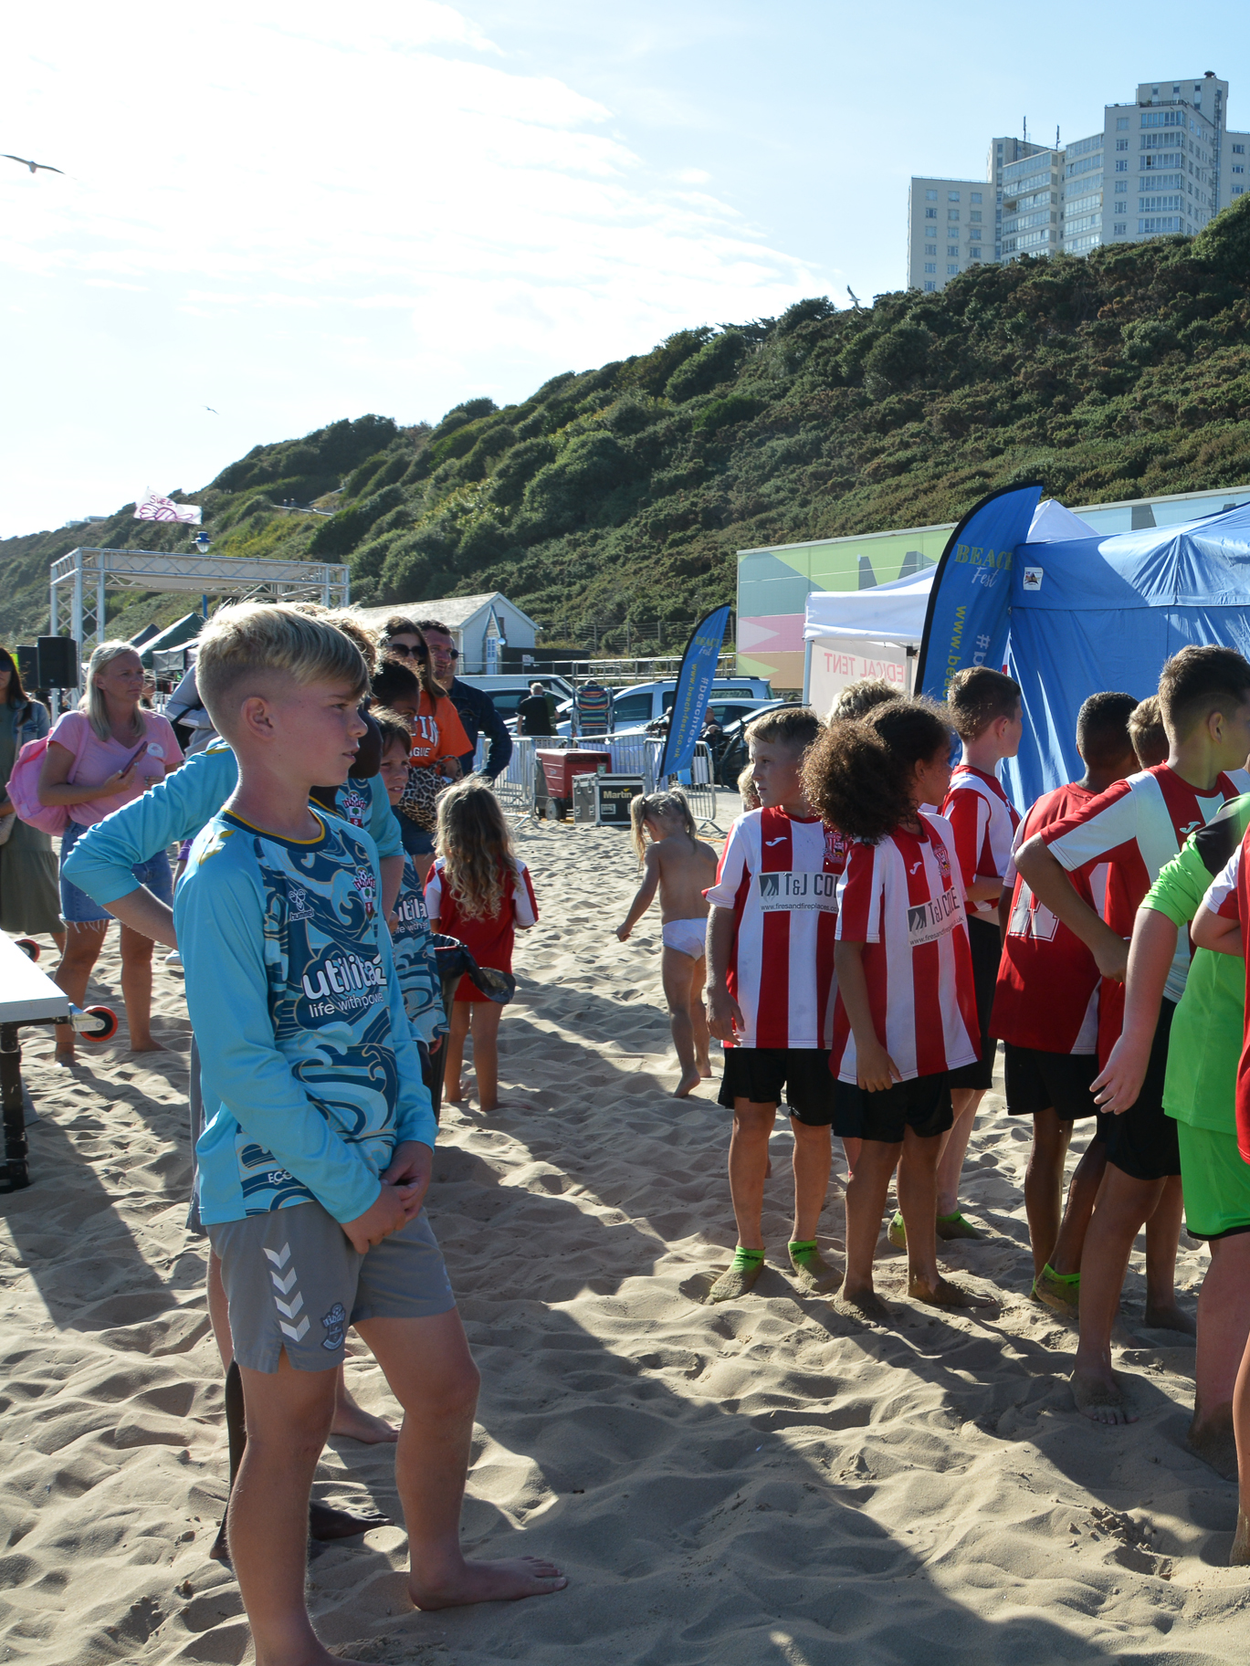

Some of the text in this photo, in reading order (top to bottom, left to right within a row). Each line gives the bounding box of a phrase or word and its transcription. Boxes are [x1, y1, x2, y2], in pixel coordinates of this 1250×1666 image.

[971, 565, 1000, 588] Fest
[603, 788, 633, 799] Martin
[783, 872, 808, 896] T&J
[289, 909, 314, 922] hummel
[308, 1001, 335, 1018] life
